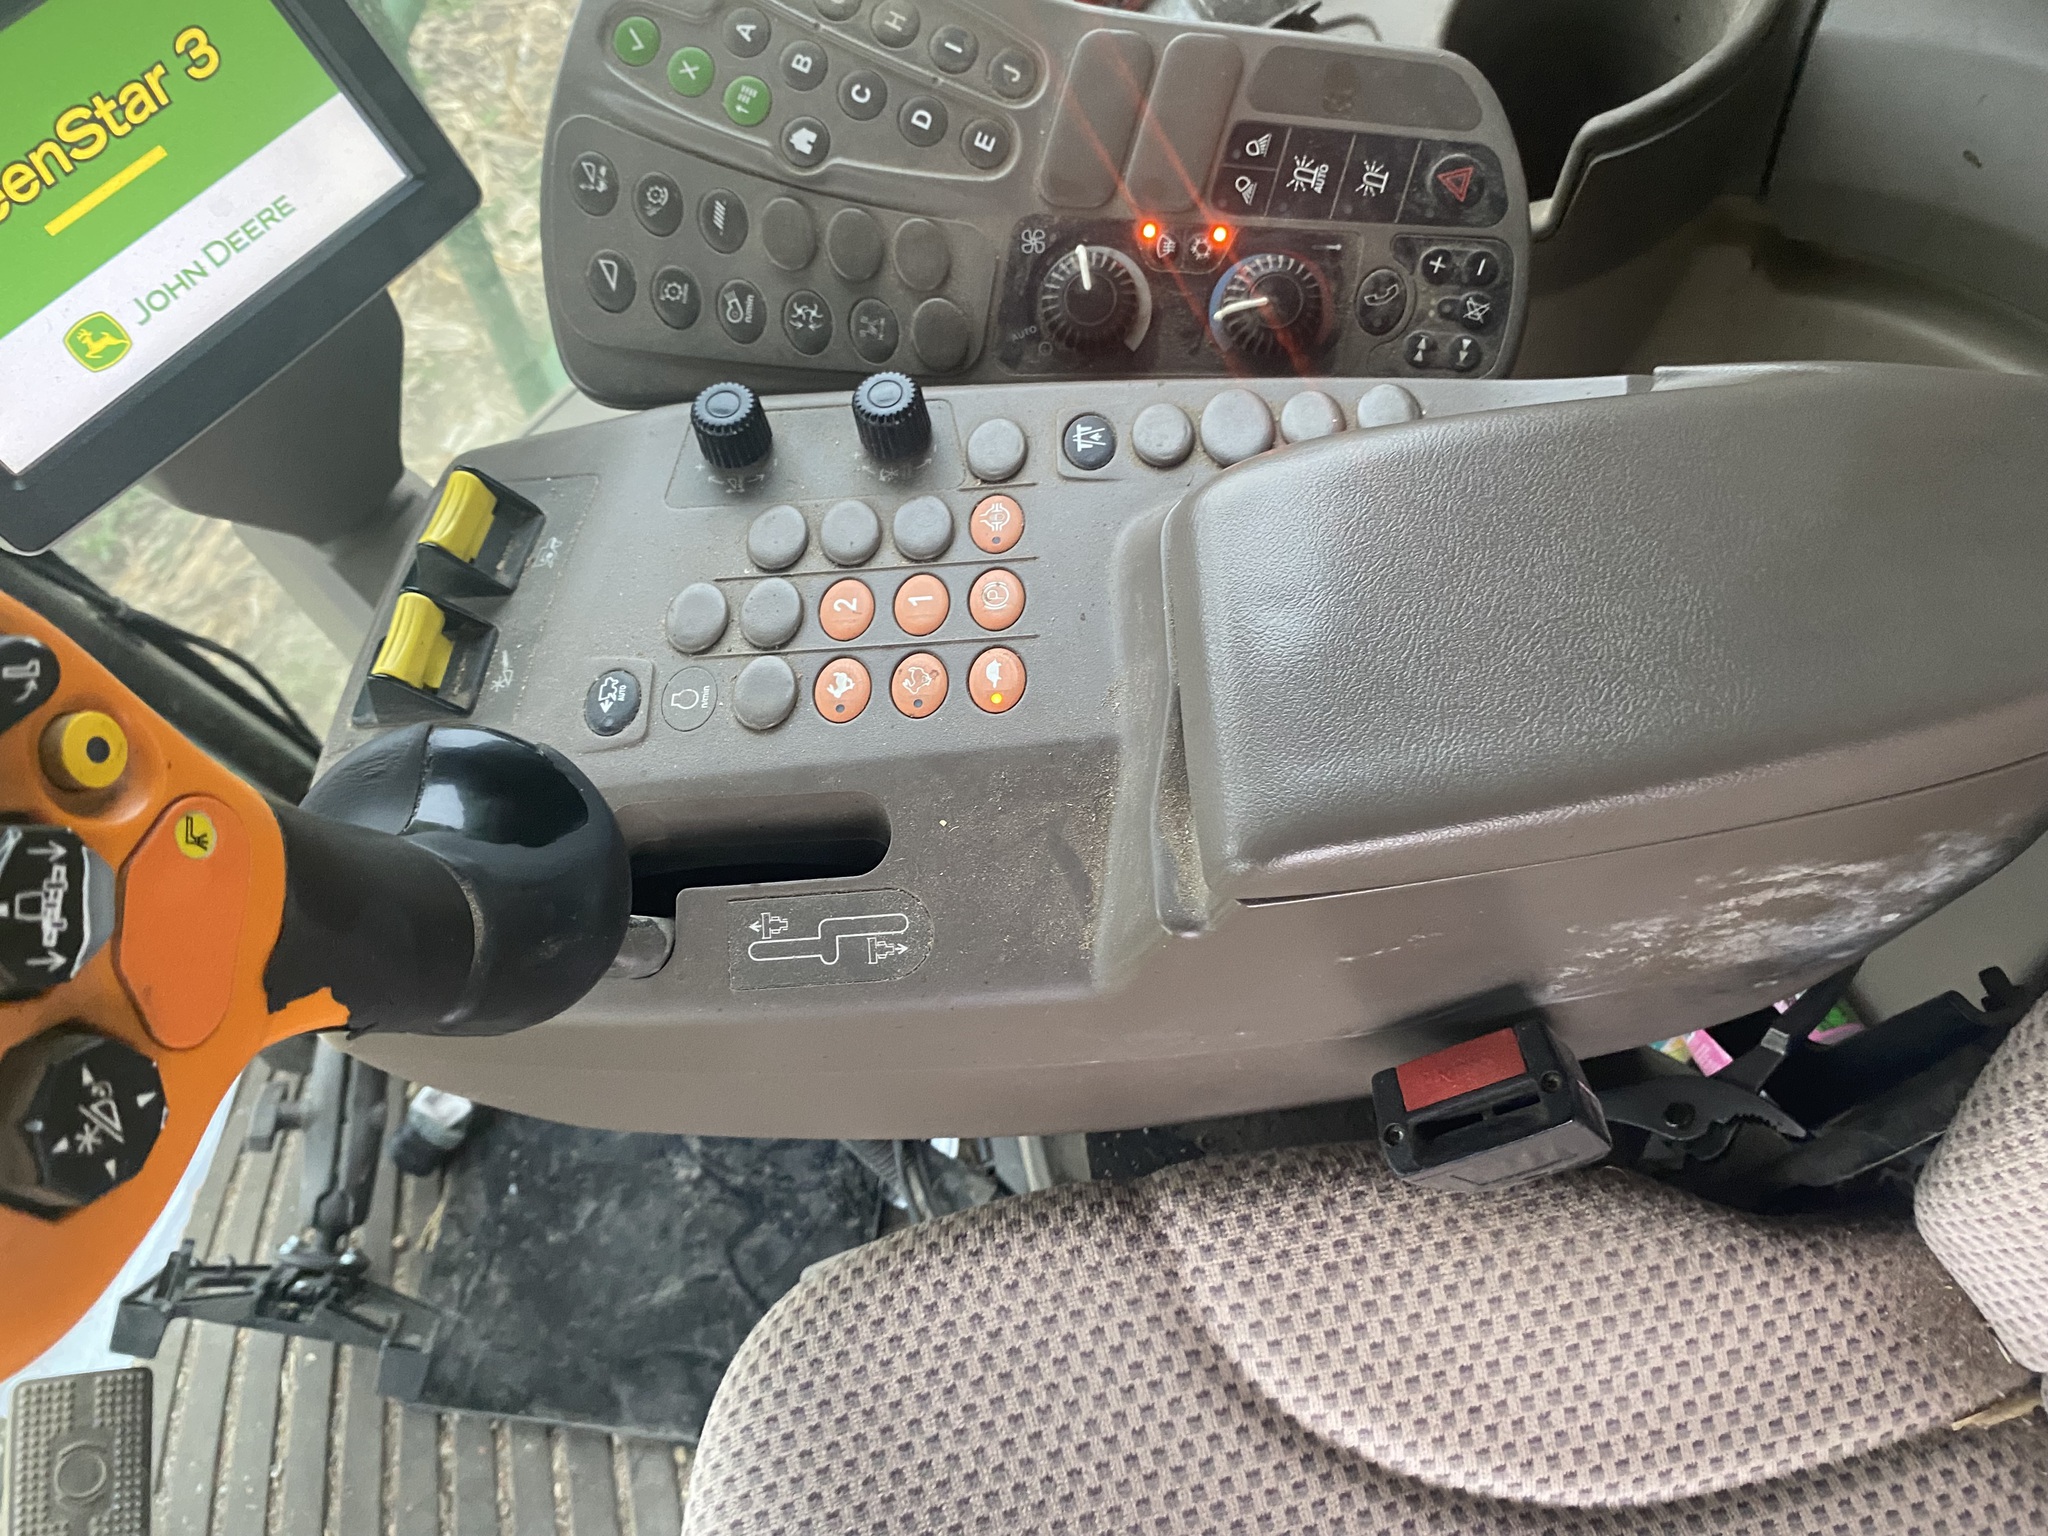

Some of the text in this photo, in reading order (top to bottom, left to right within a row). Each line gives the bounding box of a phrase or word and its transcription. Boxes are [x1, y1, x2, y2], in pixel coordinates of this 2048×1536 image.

[884, 10, 907, 32] H
[734, 23, 758, 42] A
[791, 53, 813, 74] B
[1003, 64, 1021, 82] J
[850, 83, 871, 104] C
[0, 25, 221, 224] enStar 3
[911, 109, 933, 130] D
[974, 131, 997, 153] E
[1313, 163, 1329, 194] AUTO
[133, 194, 296, 326] JOHN DEERE
[1011, 325, 1037, 341] AUTO
[833, 597, 857, 612] 2
[908, 595, 933, 606] 1
[617, 684, 627, 702] AUTO
